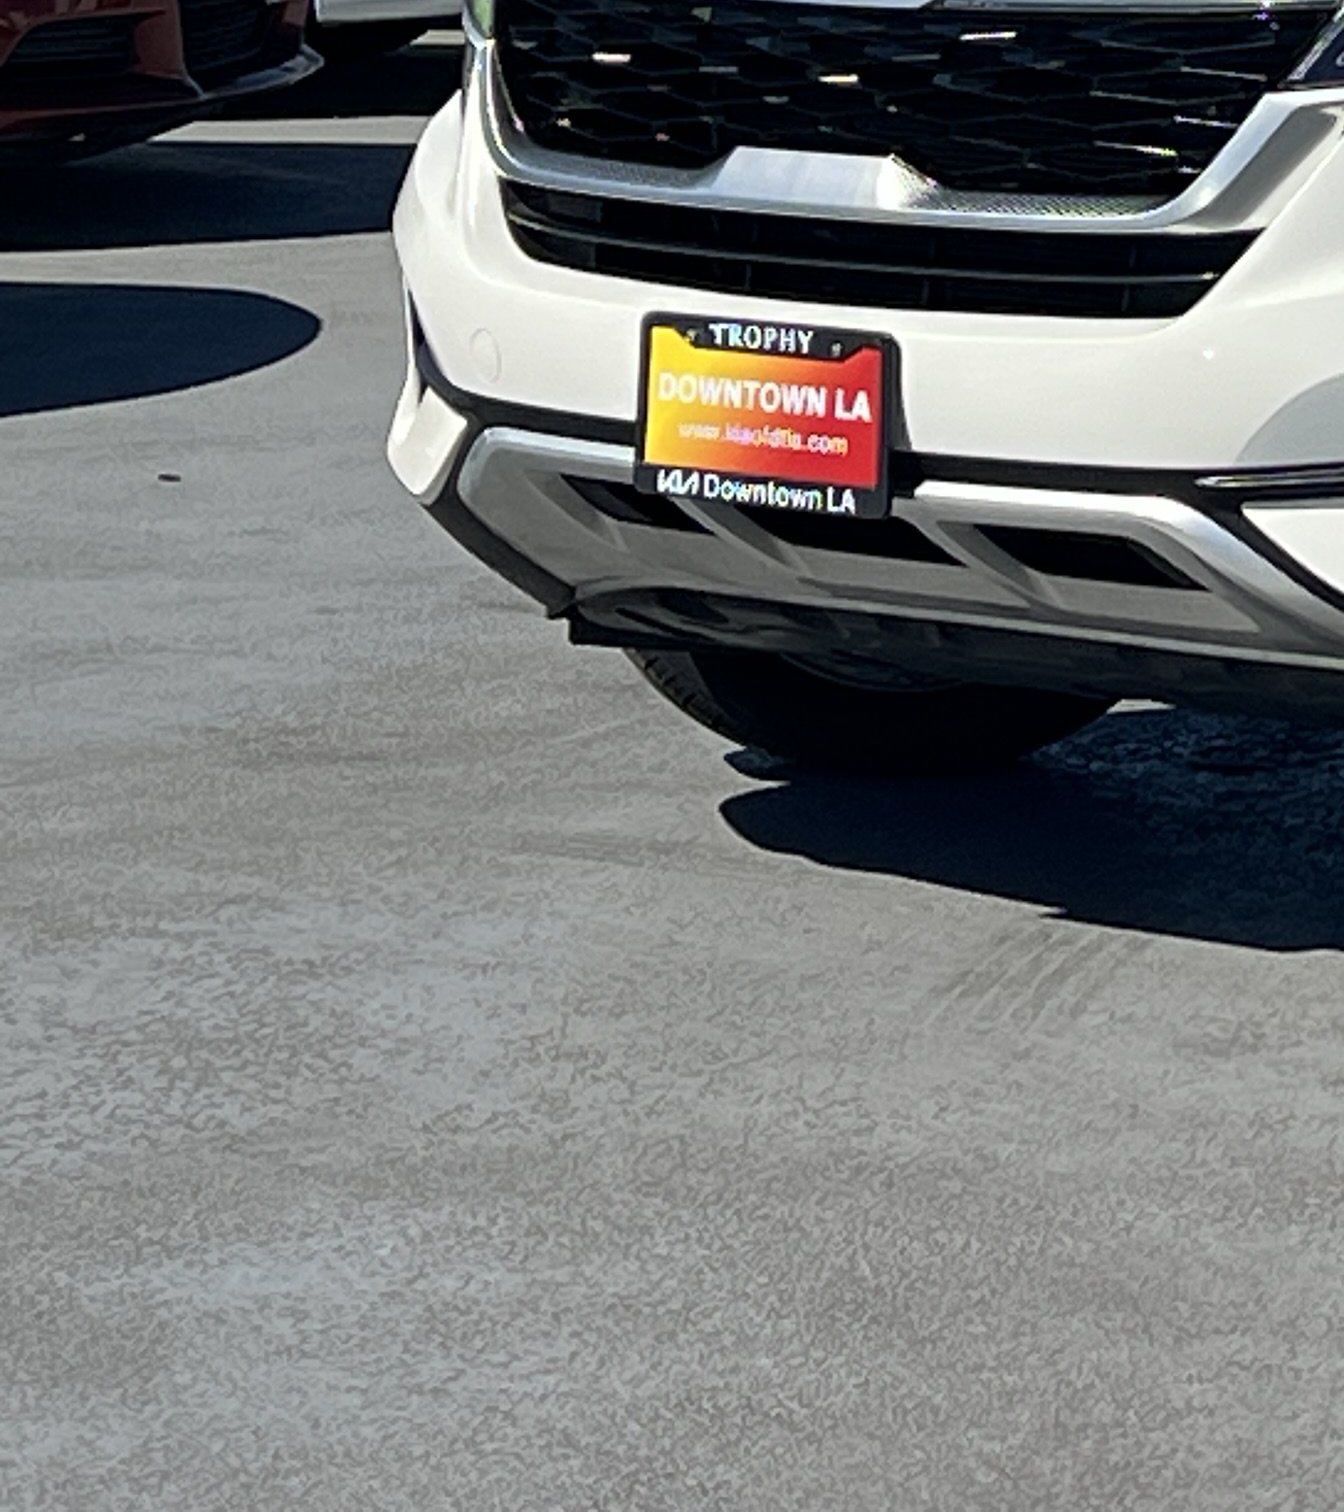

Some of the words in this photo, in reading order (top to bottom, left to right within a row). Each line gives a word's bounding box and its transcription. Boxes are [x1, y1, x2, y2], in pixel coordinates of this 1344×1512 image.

[709, 323, 814, 354] TROPHY
[657, 372, 828, 419] DOWNTOWN
[834, 388, 872, 423] LA
[656, 469, 699, 496] KIA
[703, 473, 823, 511] Downtown
[826, 486, 856, 514] LA
